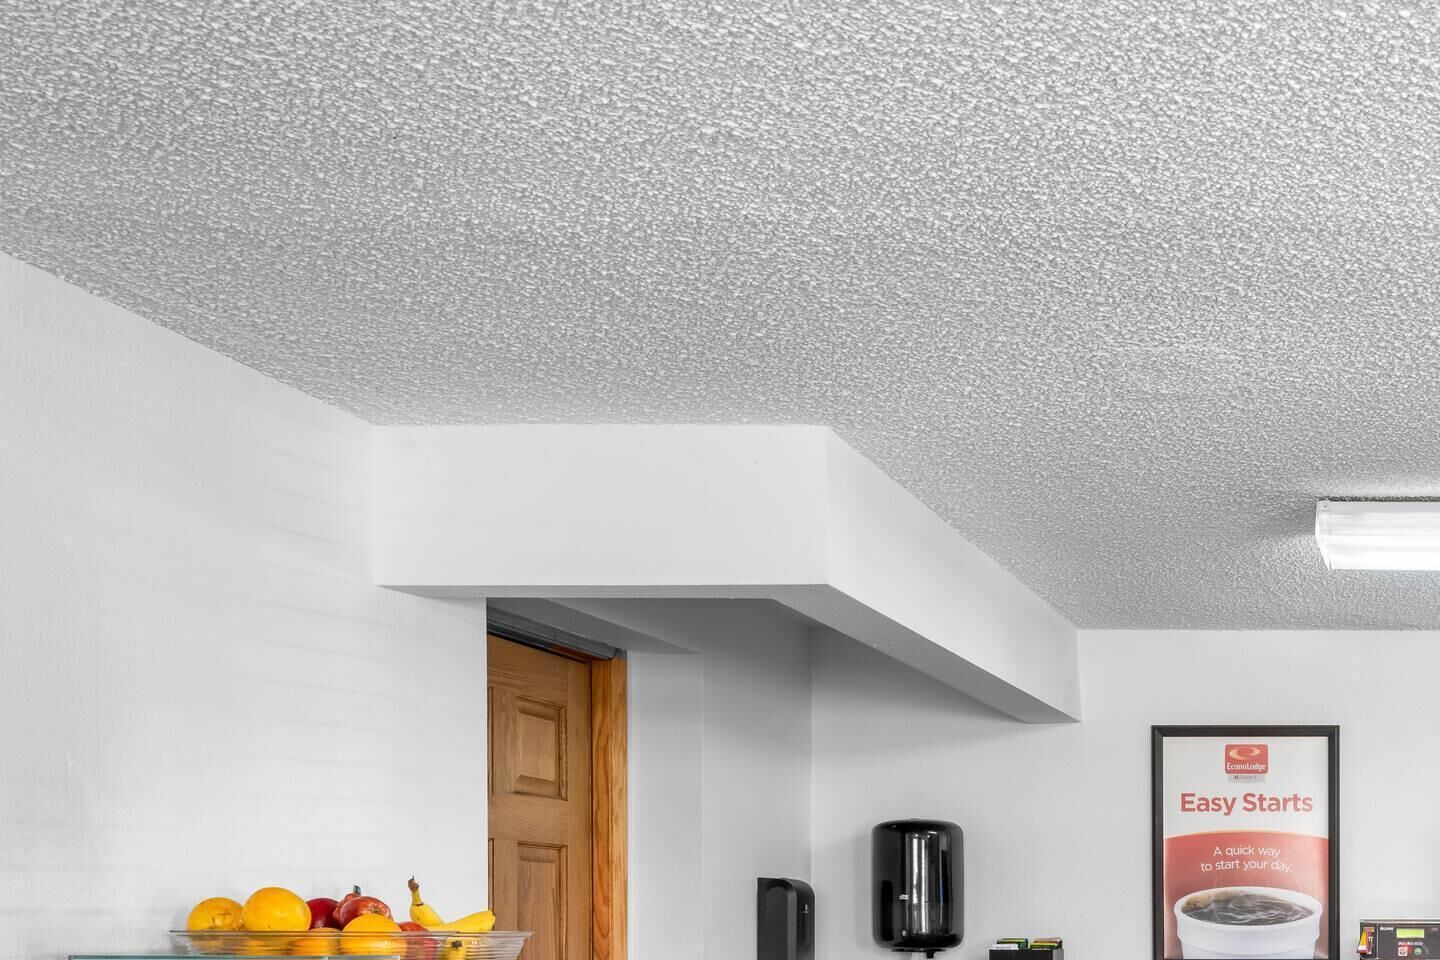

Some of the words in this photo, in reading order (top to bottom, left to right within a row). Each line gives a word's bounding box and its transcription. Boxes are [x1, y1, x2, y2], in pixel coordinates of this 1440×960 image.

[1180, 793, 1237, 816] Easy
[1242, 793, 1313, 812] Starts
[1213, 846, 1223, 857] A
[1225, 844, 1255, 857] quick
[1257, 847, 1281, 858] way
[1200, 863, 1213, 872] to
[1215, 860, 1240, 870] start
[1243, 861, 1269, 871] your
